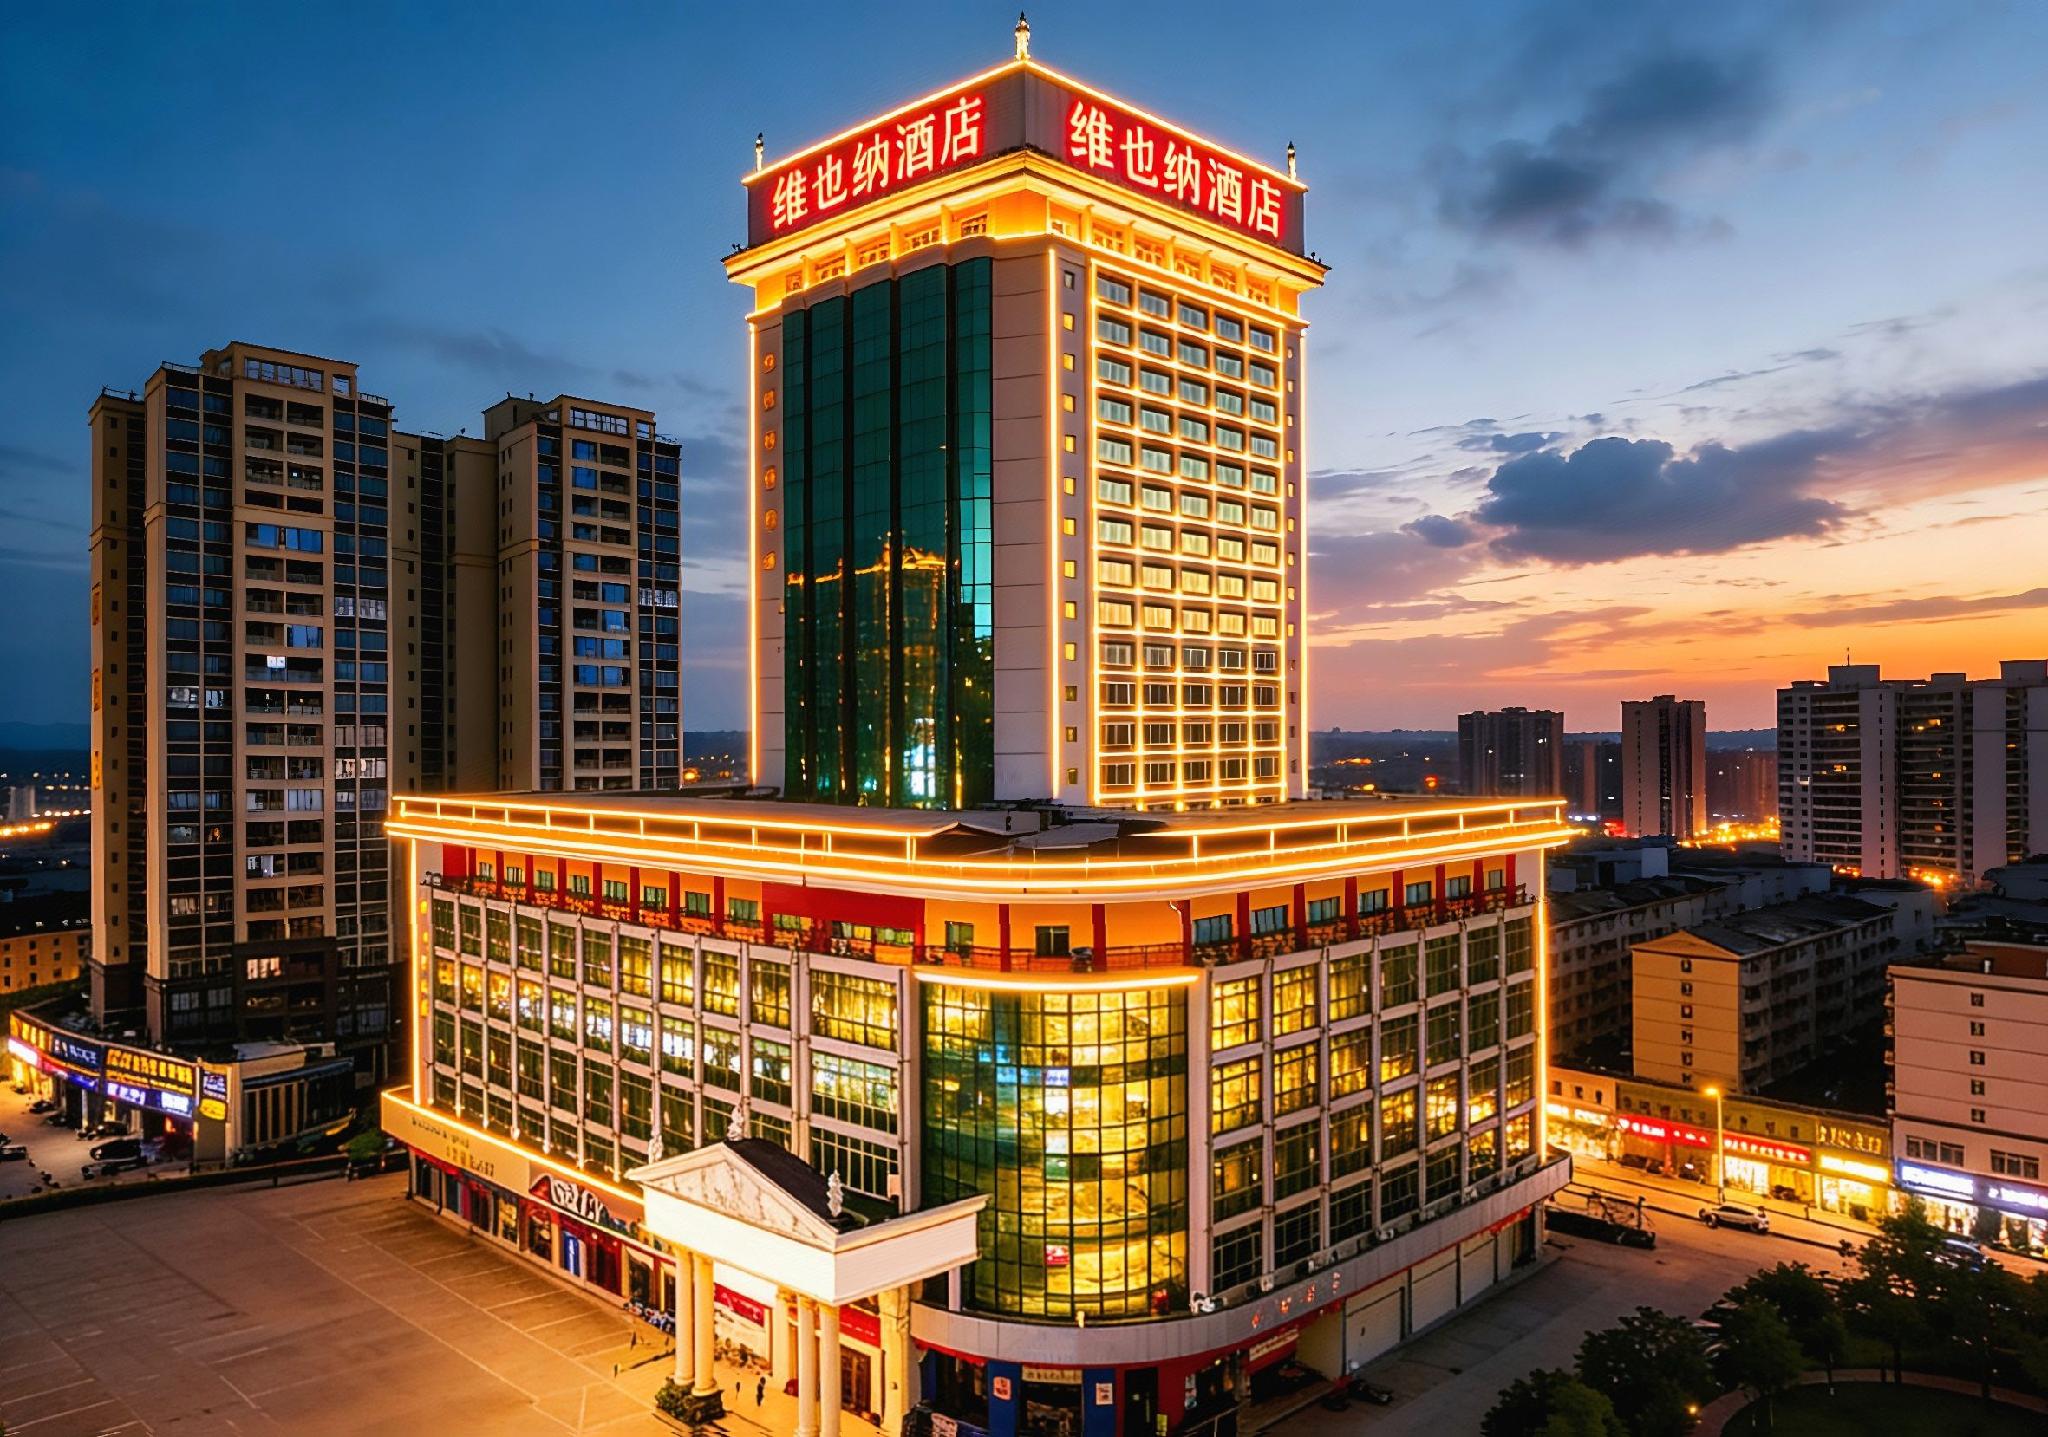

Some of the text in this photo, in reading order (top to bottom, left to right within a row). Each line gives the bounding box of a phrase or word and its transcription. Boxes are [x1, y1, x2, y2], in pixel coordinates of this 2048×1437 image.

[772, 96, 982, 229] 维也纳酒店
[1070, 100, 1282, 238] 维也纳酒店
